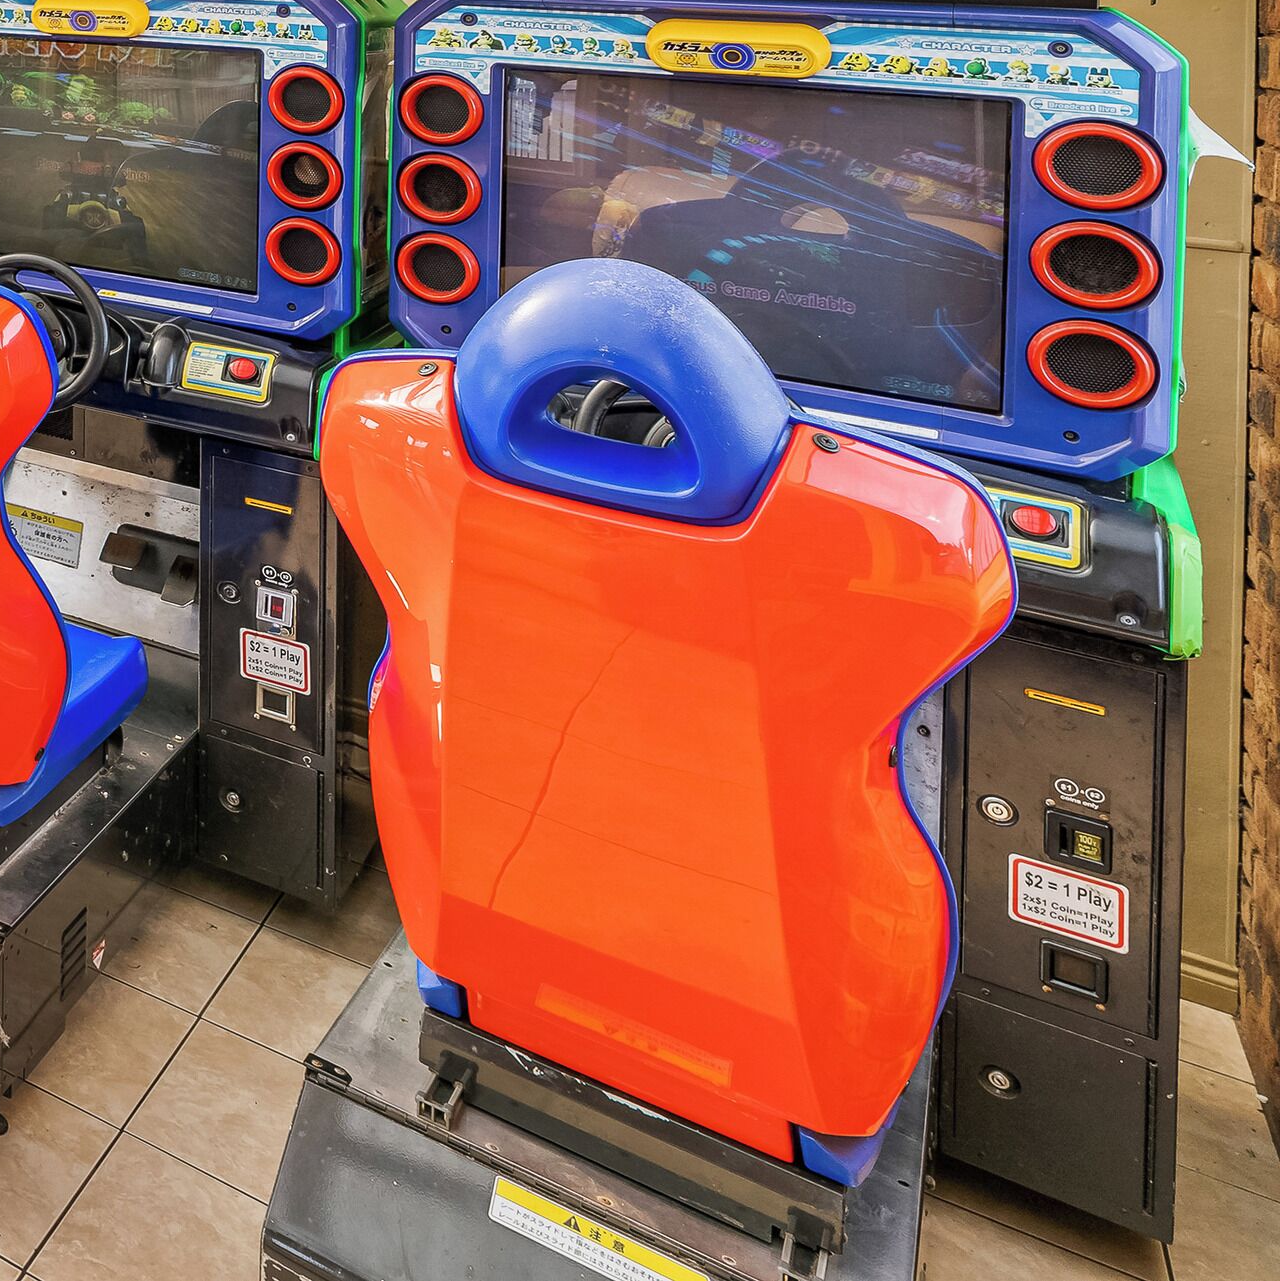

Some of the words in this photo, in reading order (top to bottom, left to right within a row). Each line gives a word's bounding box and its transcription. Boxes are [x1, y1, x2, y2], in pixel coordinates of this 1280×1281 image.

[204, 7, 256, 15] CHARACTER
[504, 21, 572, 31] CHARACTER
[921, 40, 1011, 54] CHARACTER
[1047, 101, 1096, 112] Broadcast
[1098, 105, 1116, 113] live
[721, 279, 772, 302] Game
[774, 288, 857, 314] Available
[249, 640, 261, 653] $2
[272, 647, 277, 657] 1
[280, 649, 301, 665] Play
[264, 661, 287, 672] Coin=1
[289, 667, 303, 677] Play
[264, 668, 287, 679] Coin=1
[289, 674, 303, 685] Play
[1060, 783, 1072, 792] $1
[1060, 794, 1081, 805] coins
[1082, 800, 1099, 810] only
[1023, 893, 1047, 906] 2x$1
[1025, 872, 1043, 889] $2
[1048, 881, 1057, 891] =
[1063, 883, 1070, 897] 1
[1077, 887, 1112, 912] Play
[1022, 903, 1046, 916] 1x$2
[1049, 911, 1087, 928] Coin=1
[1091, 923, 1115, 938] Play
[589, 1227, 626, 1253] 注意
